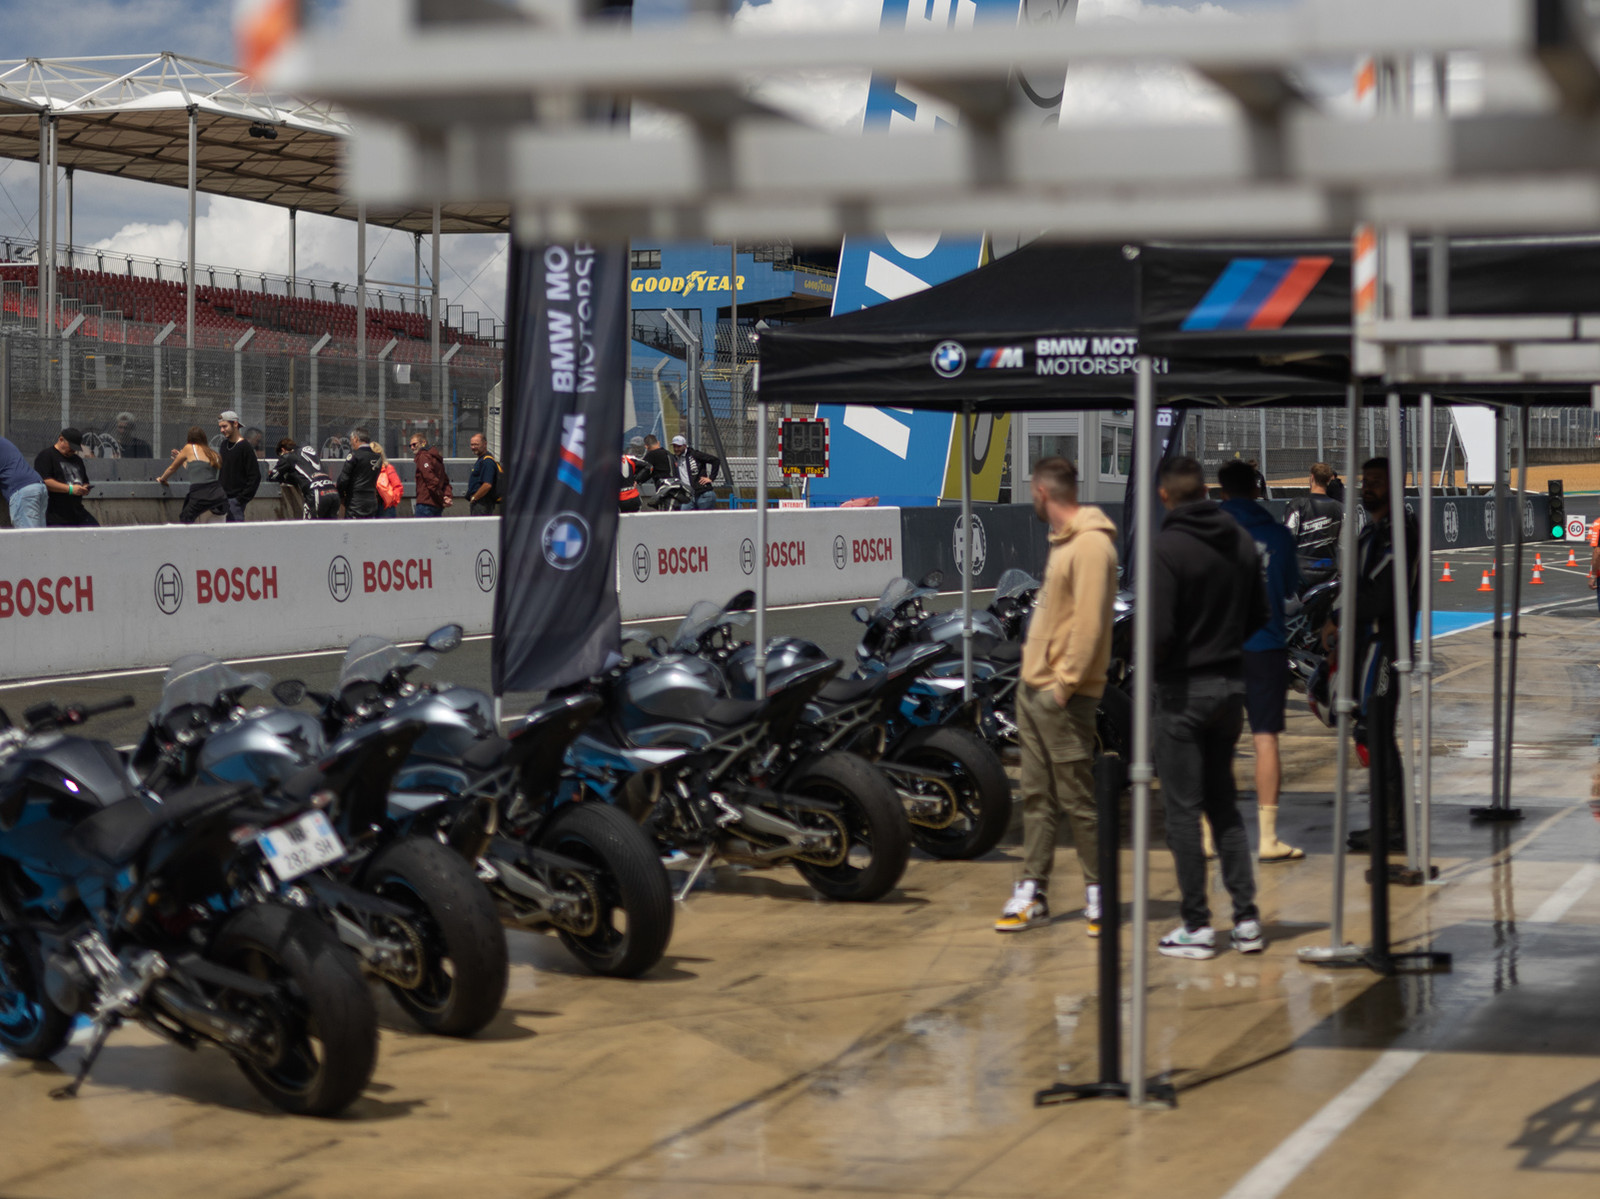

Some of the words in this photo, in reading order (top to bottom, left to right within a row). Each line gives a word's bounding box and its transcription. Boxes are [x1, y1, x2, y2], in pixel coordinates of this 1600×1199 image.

[547, 310, 575, 393] BMW
[1036, 338, 1087, 356] BMW
[1091, 338, 1139, 355] MOT
[1570, 524, 1582, 533] 60
[658, 546, 708, 575] BOSCH
[852, 538, 893, 563] BOSCH
[196, 566, 278, 604] BOSCH
[363, 558, 433, 593] BOSCH
[0, 575, 94, 619] BOSCH
